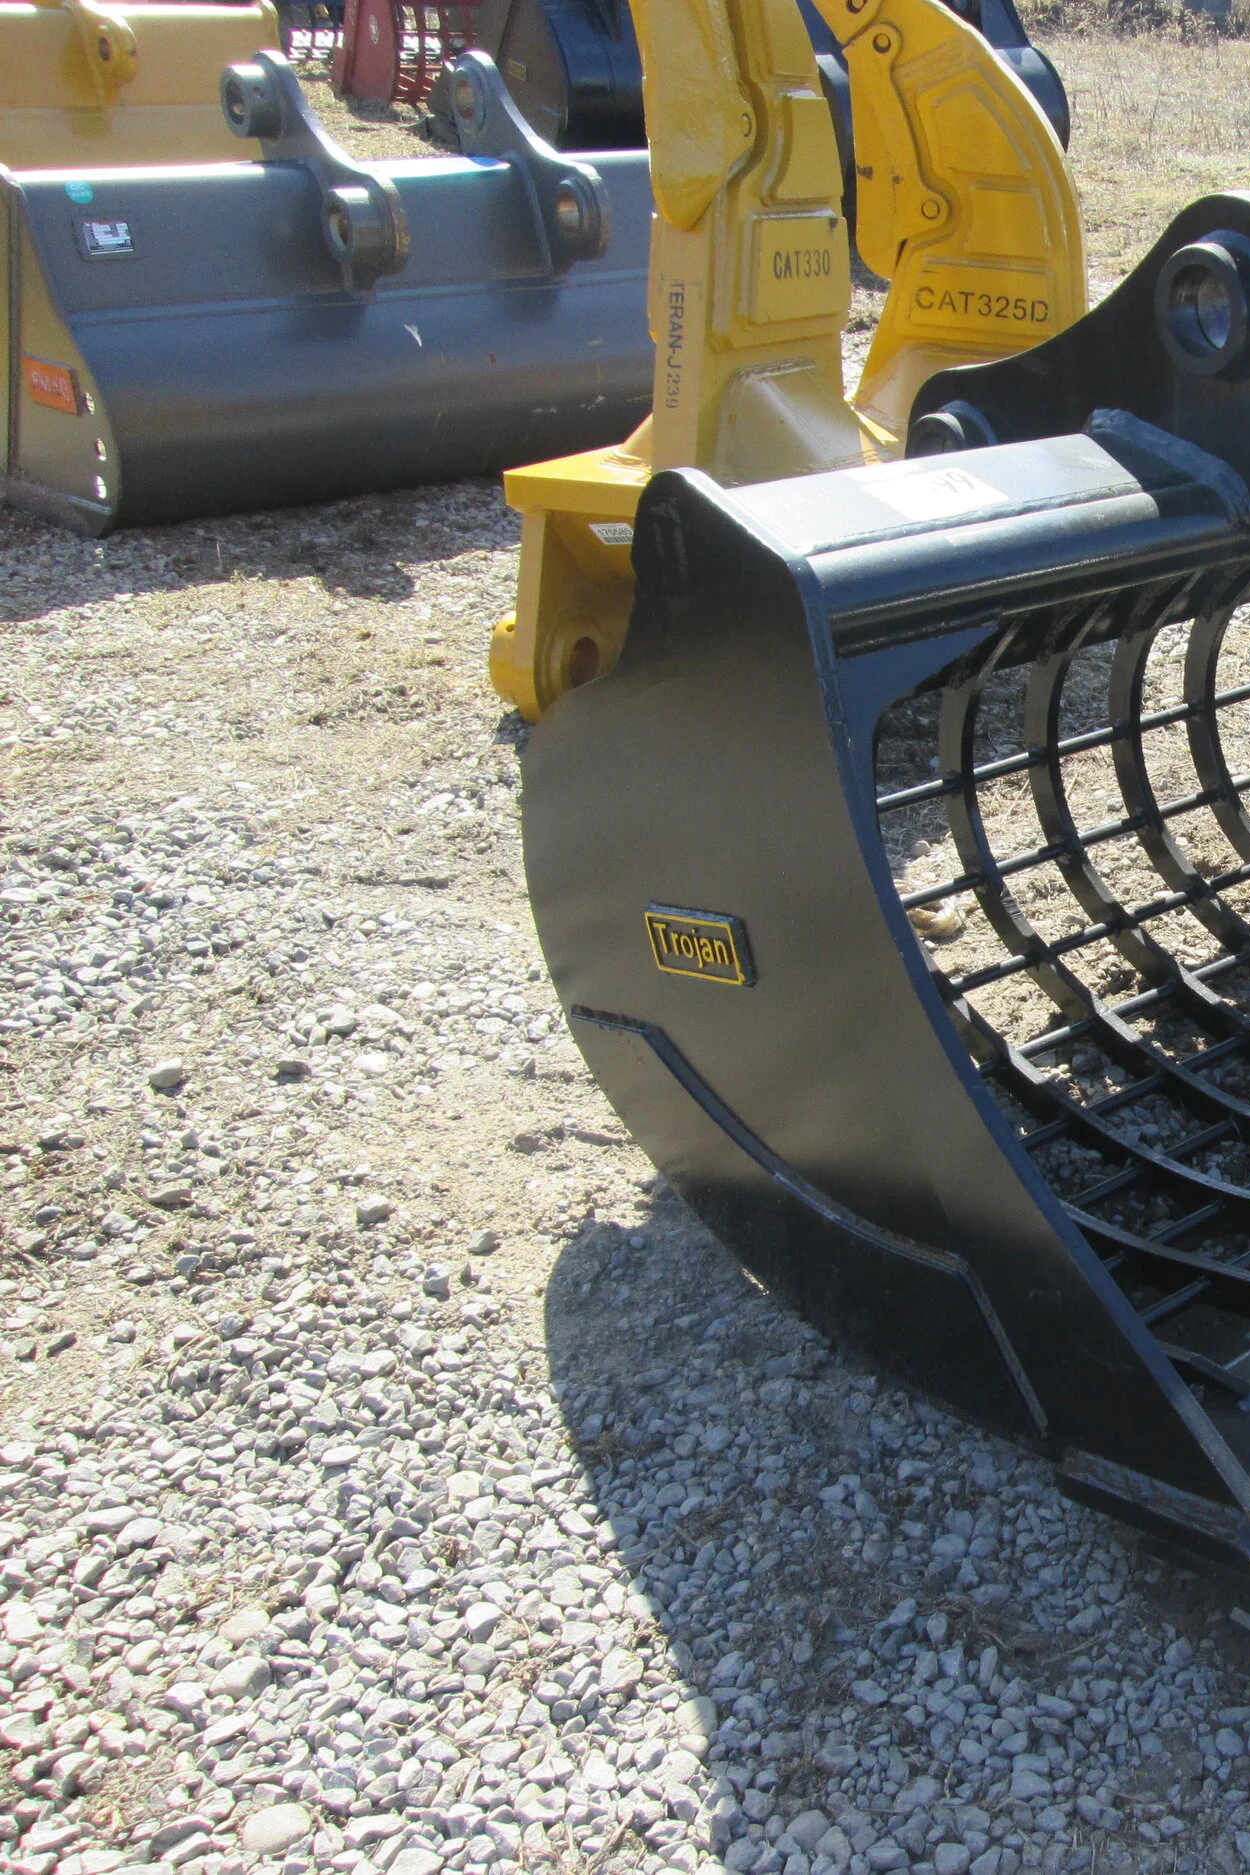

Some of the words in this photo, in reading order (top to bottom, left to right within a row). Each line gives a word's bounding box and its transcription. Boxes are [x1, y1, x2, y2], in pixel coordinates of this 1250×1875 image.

[773, 249, 831, 279] CAT330
[915, 286, 1049, 323] CAT325D
[652, 922, 730, 968] Trojan
